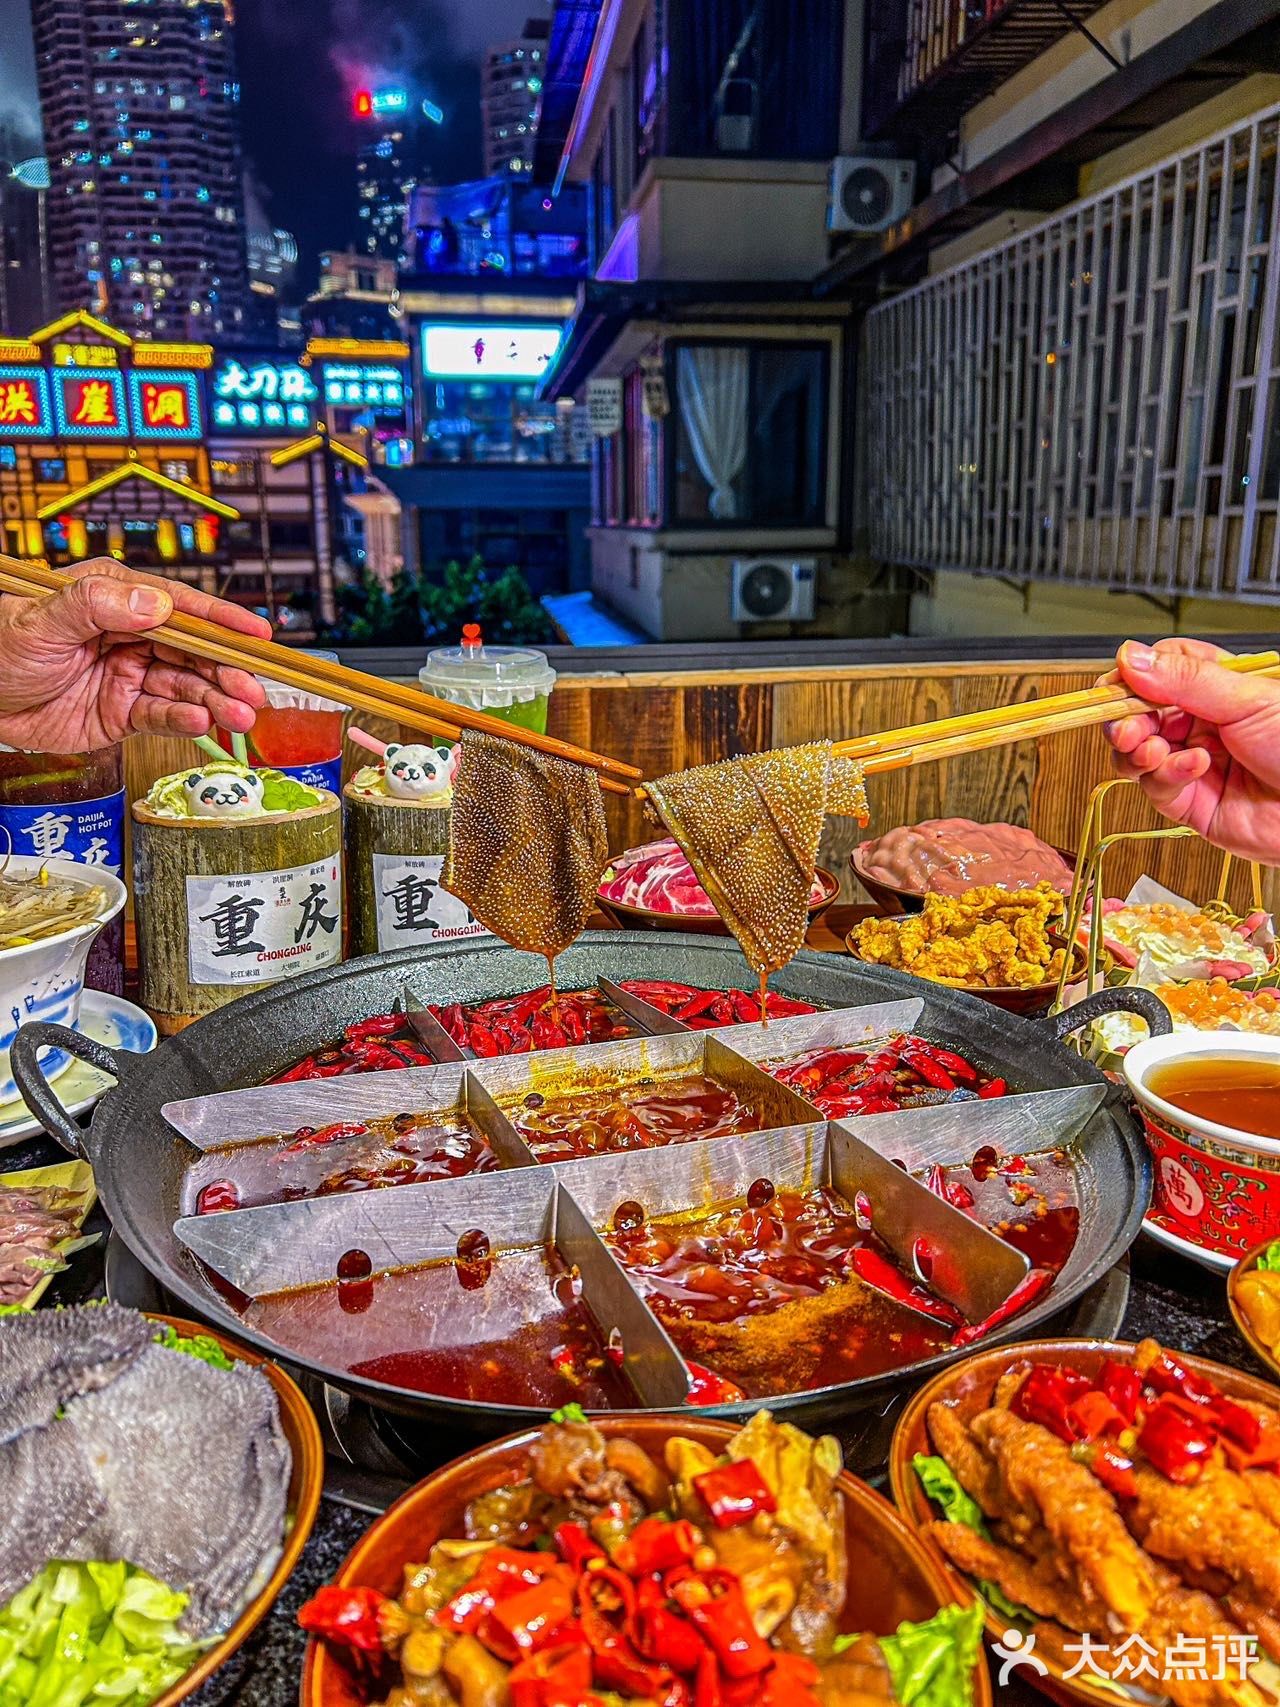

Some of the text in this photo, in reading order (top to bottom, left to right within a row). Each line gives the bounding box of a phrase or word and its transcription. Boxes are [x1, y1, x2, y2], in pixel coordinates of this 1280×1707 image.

[0, 381, 184, 426] 洪崖洞
[78, 811, 105, 824] DAIJIA
[78, 819, 113, 834] HOT POT
[227, 879, 252, 888] 解放碑
[199, 883, 339, 957] 重庆
[432, 924, 486, 938] CHONGQING
[256, 942, 312, 962] CHONGQING
